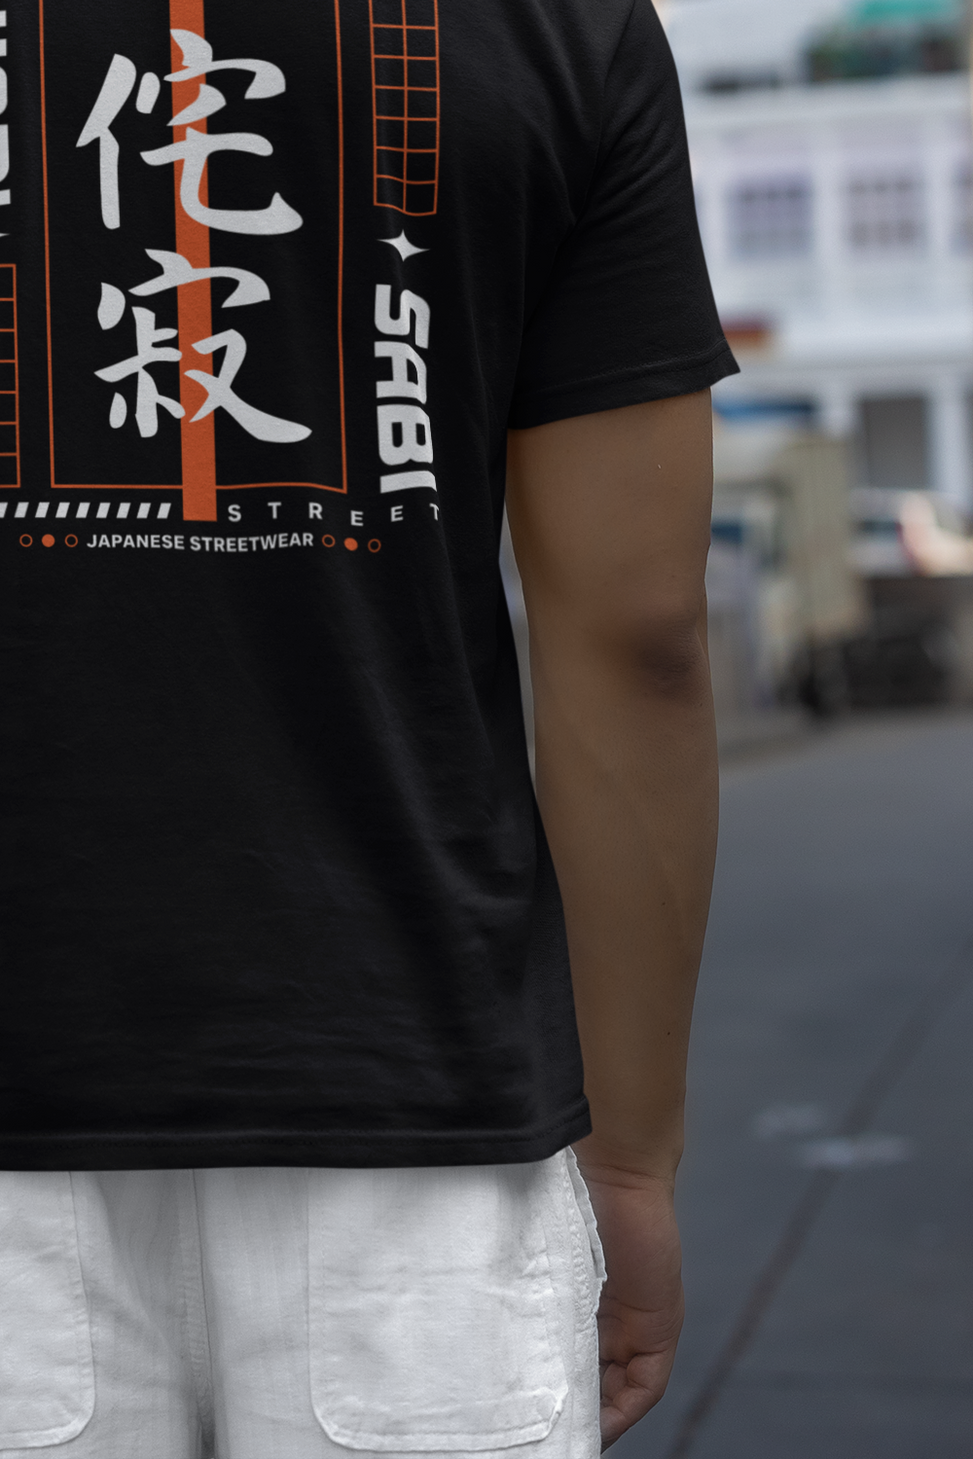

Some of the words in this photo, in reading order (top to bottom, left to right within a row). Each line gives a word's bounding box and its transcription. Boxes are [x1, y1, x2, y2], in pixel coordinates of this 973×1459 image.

[373, 283, 438, 494] SABI
[227, 501, 440, 527] STREET
[86, 534, 185, 550] JAPANESE
[189, 532, 314, 553] STREETWEAR
